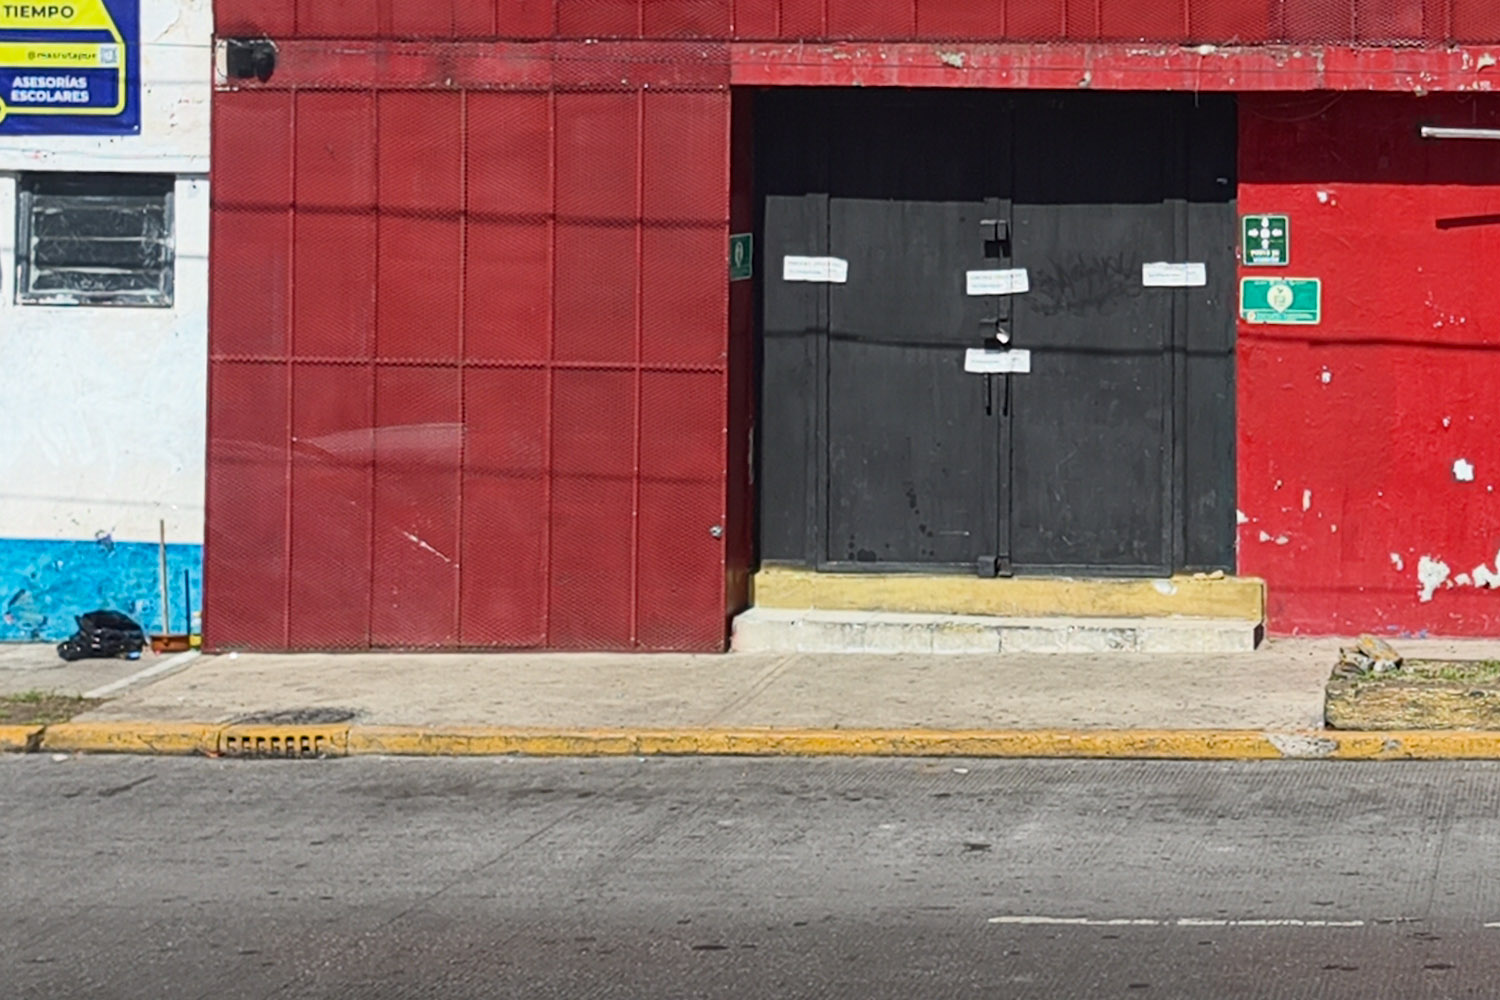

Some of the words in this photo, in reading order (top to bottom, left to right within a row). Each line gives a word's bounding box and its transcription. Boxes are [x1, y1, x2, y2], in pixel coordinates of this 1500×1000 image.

[3, 4, 74, 18] TIEMPO
[12, 75, 88, 89] ASESORÍAS
[10, 90, 90, 103] ESCOLARES
